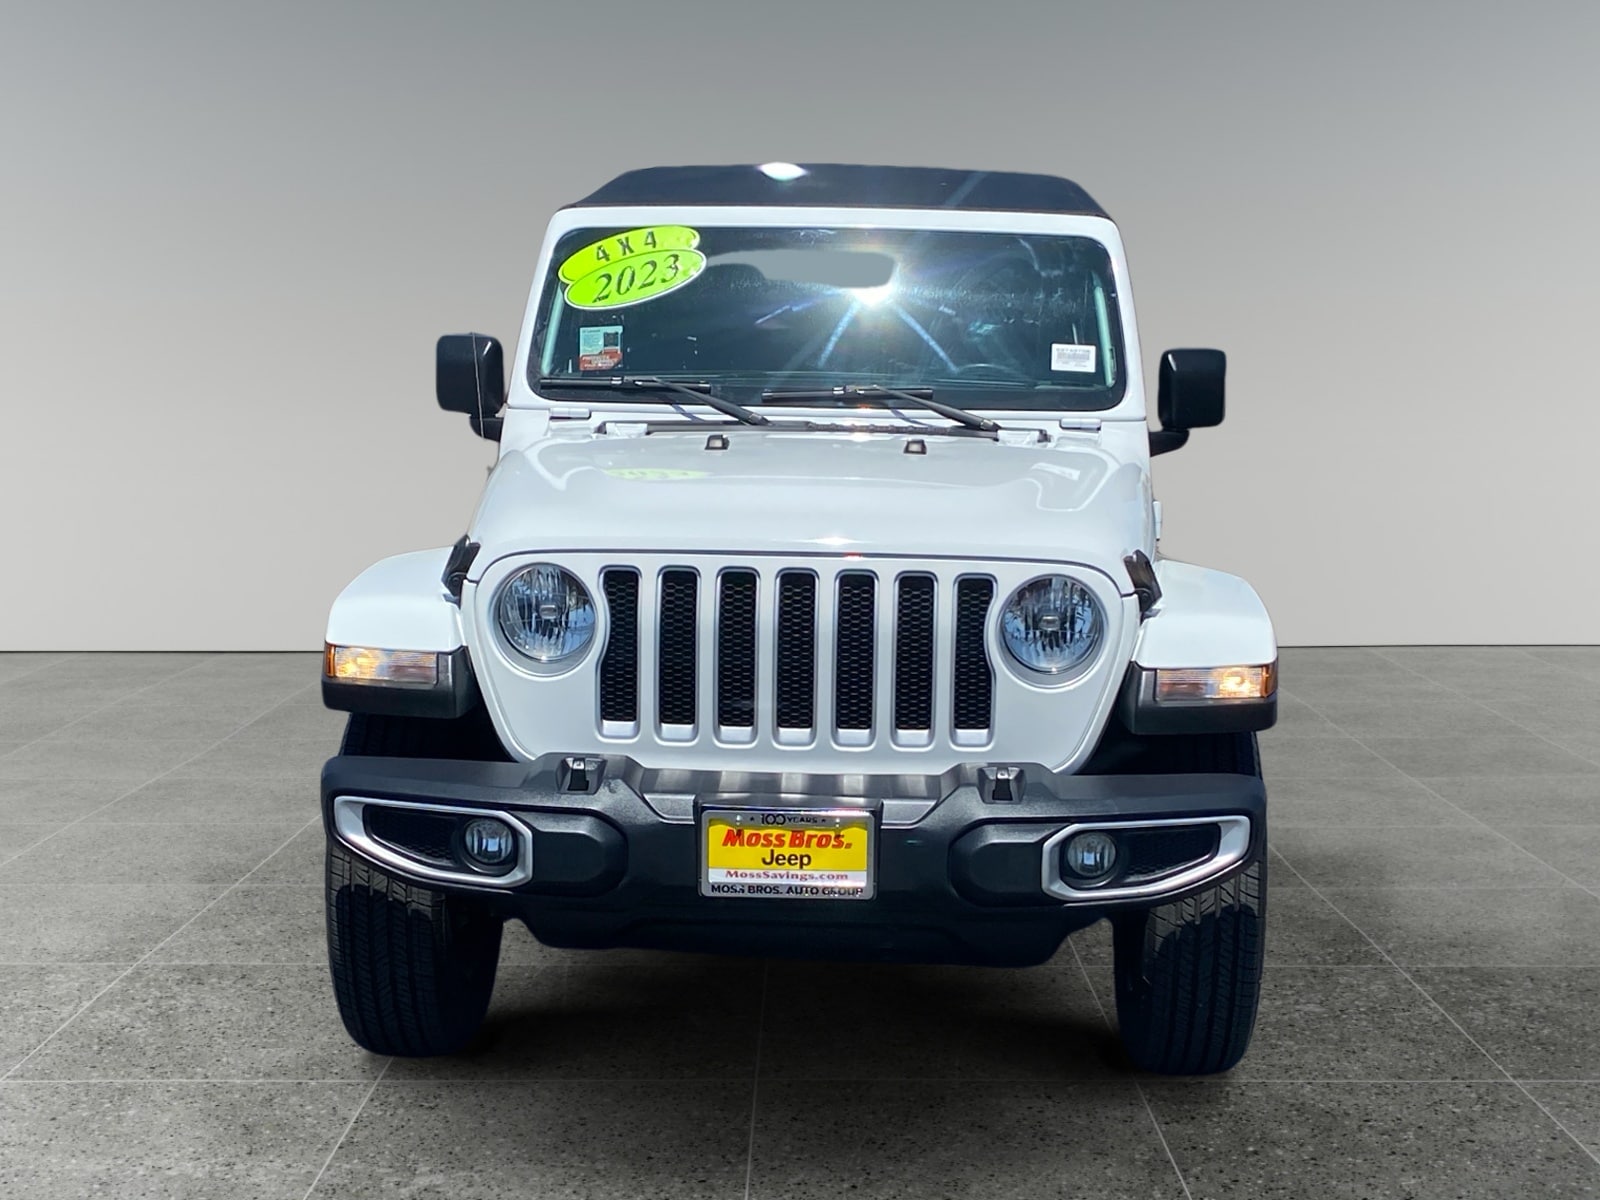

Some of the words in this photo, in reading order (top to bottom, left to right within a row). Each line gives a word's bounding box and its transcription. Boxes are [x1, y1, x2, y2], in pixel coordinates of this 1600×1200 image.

[592, 254, 680, 303] 2023
[722, 828, 786, 848] Moss
[789, 830, 852, 849] Bros.
[762, 849, 812, 869] Jeep
[725, 870, 849, 882] MossSavings.com
[748, 885, 783, 895] BROS.
[786, 886, 819, 896] AUTO
[822, 886, 863, 897] GROUP
